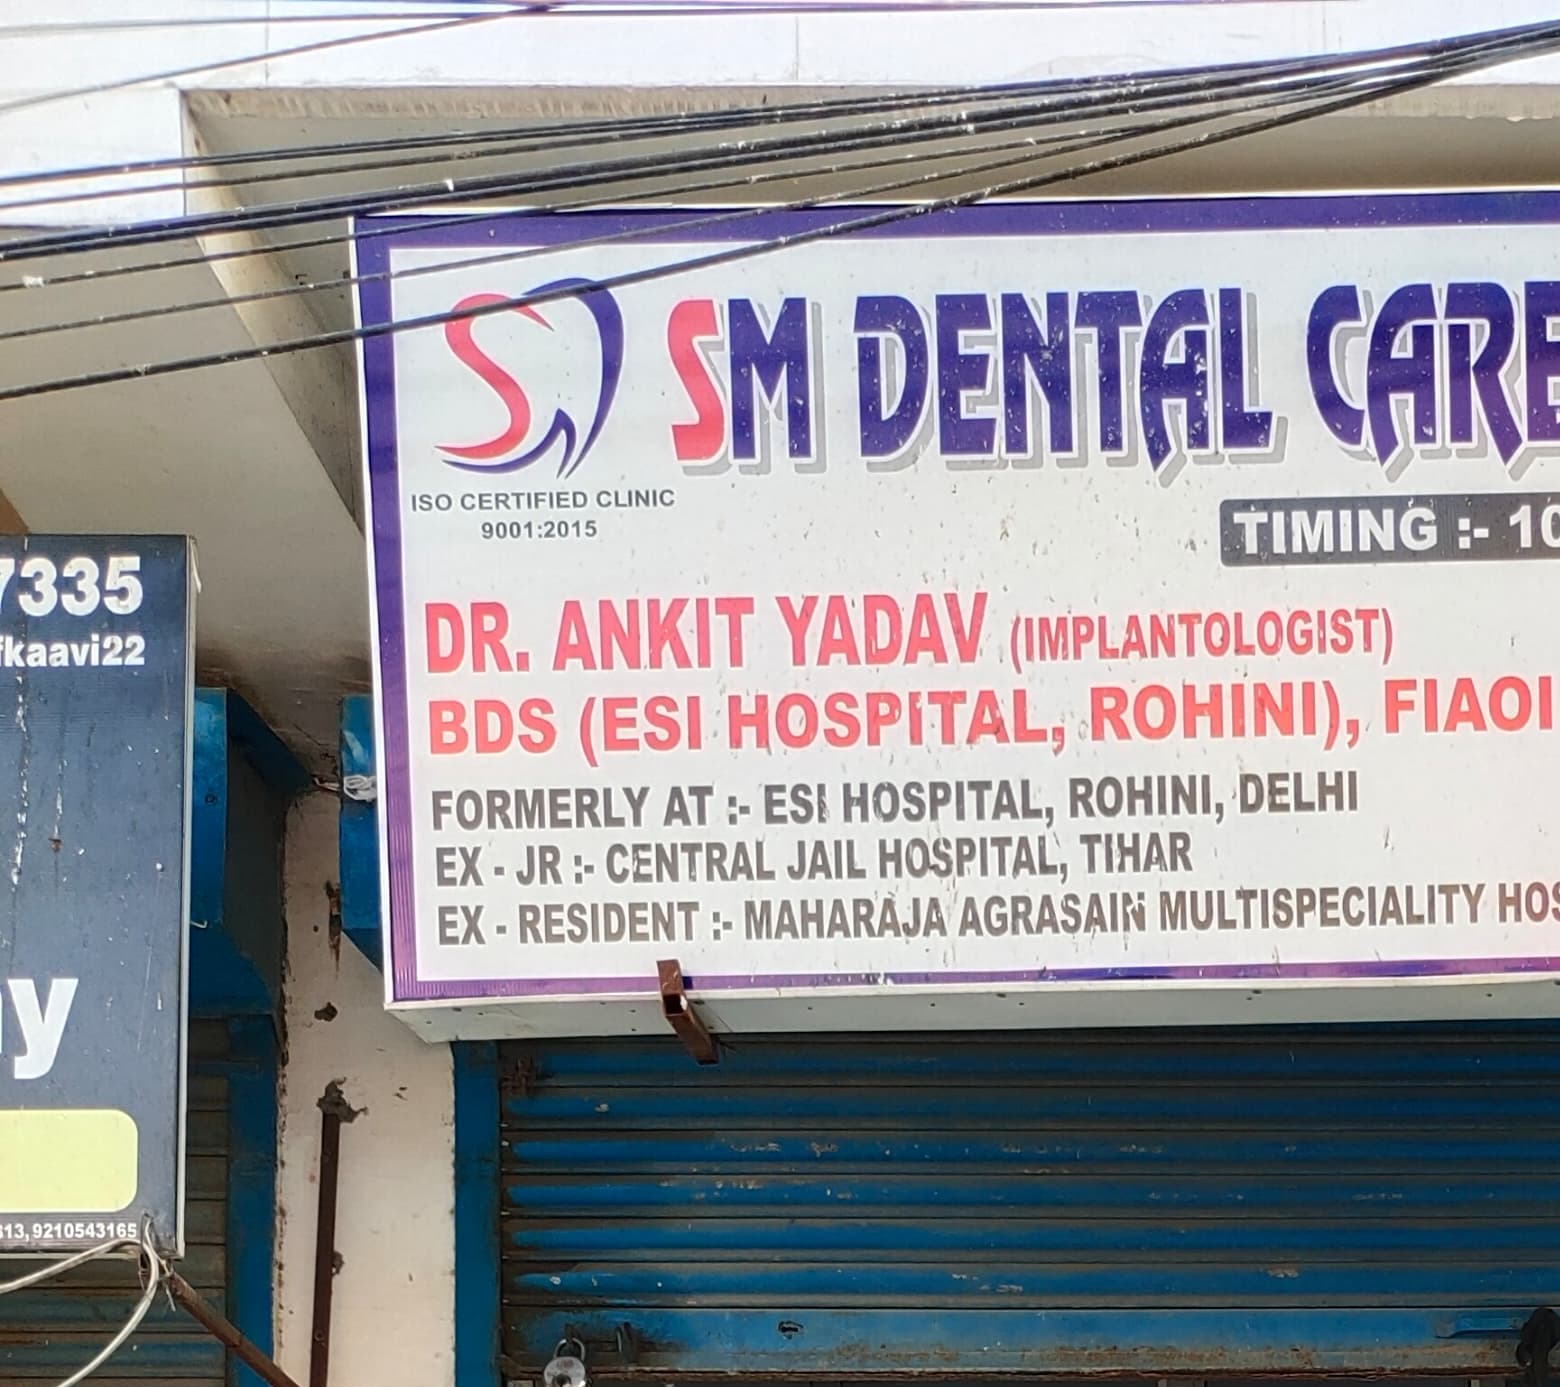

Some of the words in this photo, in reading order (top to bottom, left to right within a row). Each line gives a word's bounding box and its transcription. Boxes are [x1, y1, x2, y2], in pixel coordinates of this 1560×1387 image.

[666, 297, 817, 465] SM
[853, 286, 1280, 474] DENTAL
[411, 493, 453, 512] ISO
[460, 490, 589, 511] CERTIFIED
[596, 487, 676, 509] CLINIC
[481, 519, 598, 541] 9001:2015
[1233, 506, 1438, 556] TIMING
[0, 632, 146, 668] kaavi22
[425, 601, 530, 674] DR.
[552, 597, 755, 672] ANKIT
[775, 591, 988, 667] YADAV
[1010, 607, 1394, 675] (IMPLANTOLOGIST)
[428, 697, 557, 755] BDS
[579, 694, 702, 767] (ESI
[727, 688, 1066, 756] HOSPITAL,
[1089, 678, 1361, 753] ROHINI),
[1384, 675, 1554, 735] FIAOI
[432, 785, 650, 831] FORMERLY
[663, 784, 714, 828] AT
[764, 782, 828, 825] ESI
[843, 777, 1054, 829] HOSPITAL,
[1068, 771, 1227, 825] ROHINI,
[1239, 769, 1360, 815] DELHI
[435, 844, 483, 888] EX
[515, 842, 563, 886] JR
[606, 839, 776, 884] CENTRAL
[786, 837, 866, 882] JAIL
[878, 833, 1069, 884] HOSPITAL,
[1080, 830, 1193, 874] TIHAR
[438, 904, 487, 946] EX
[518, 900, 700, 946] RESIDENT
[744, 897, 948, 941] MAHARAJA
[958, 891, 1147, 937] AGRASAIN
[1160, 881, 1486, 933] MULTISPECIALITY
[32, 1222, 138, 1240] 9210543165
